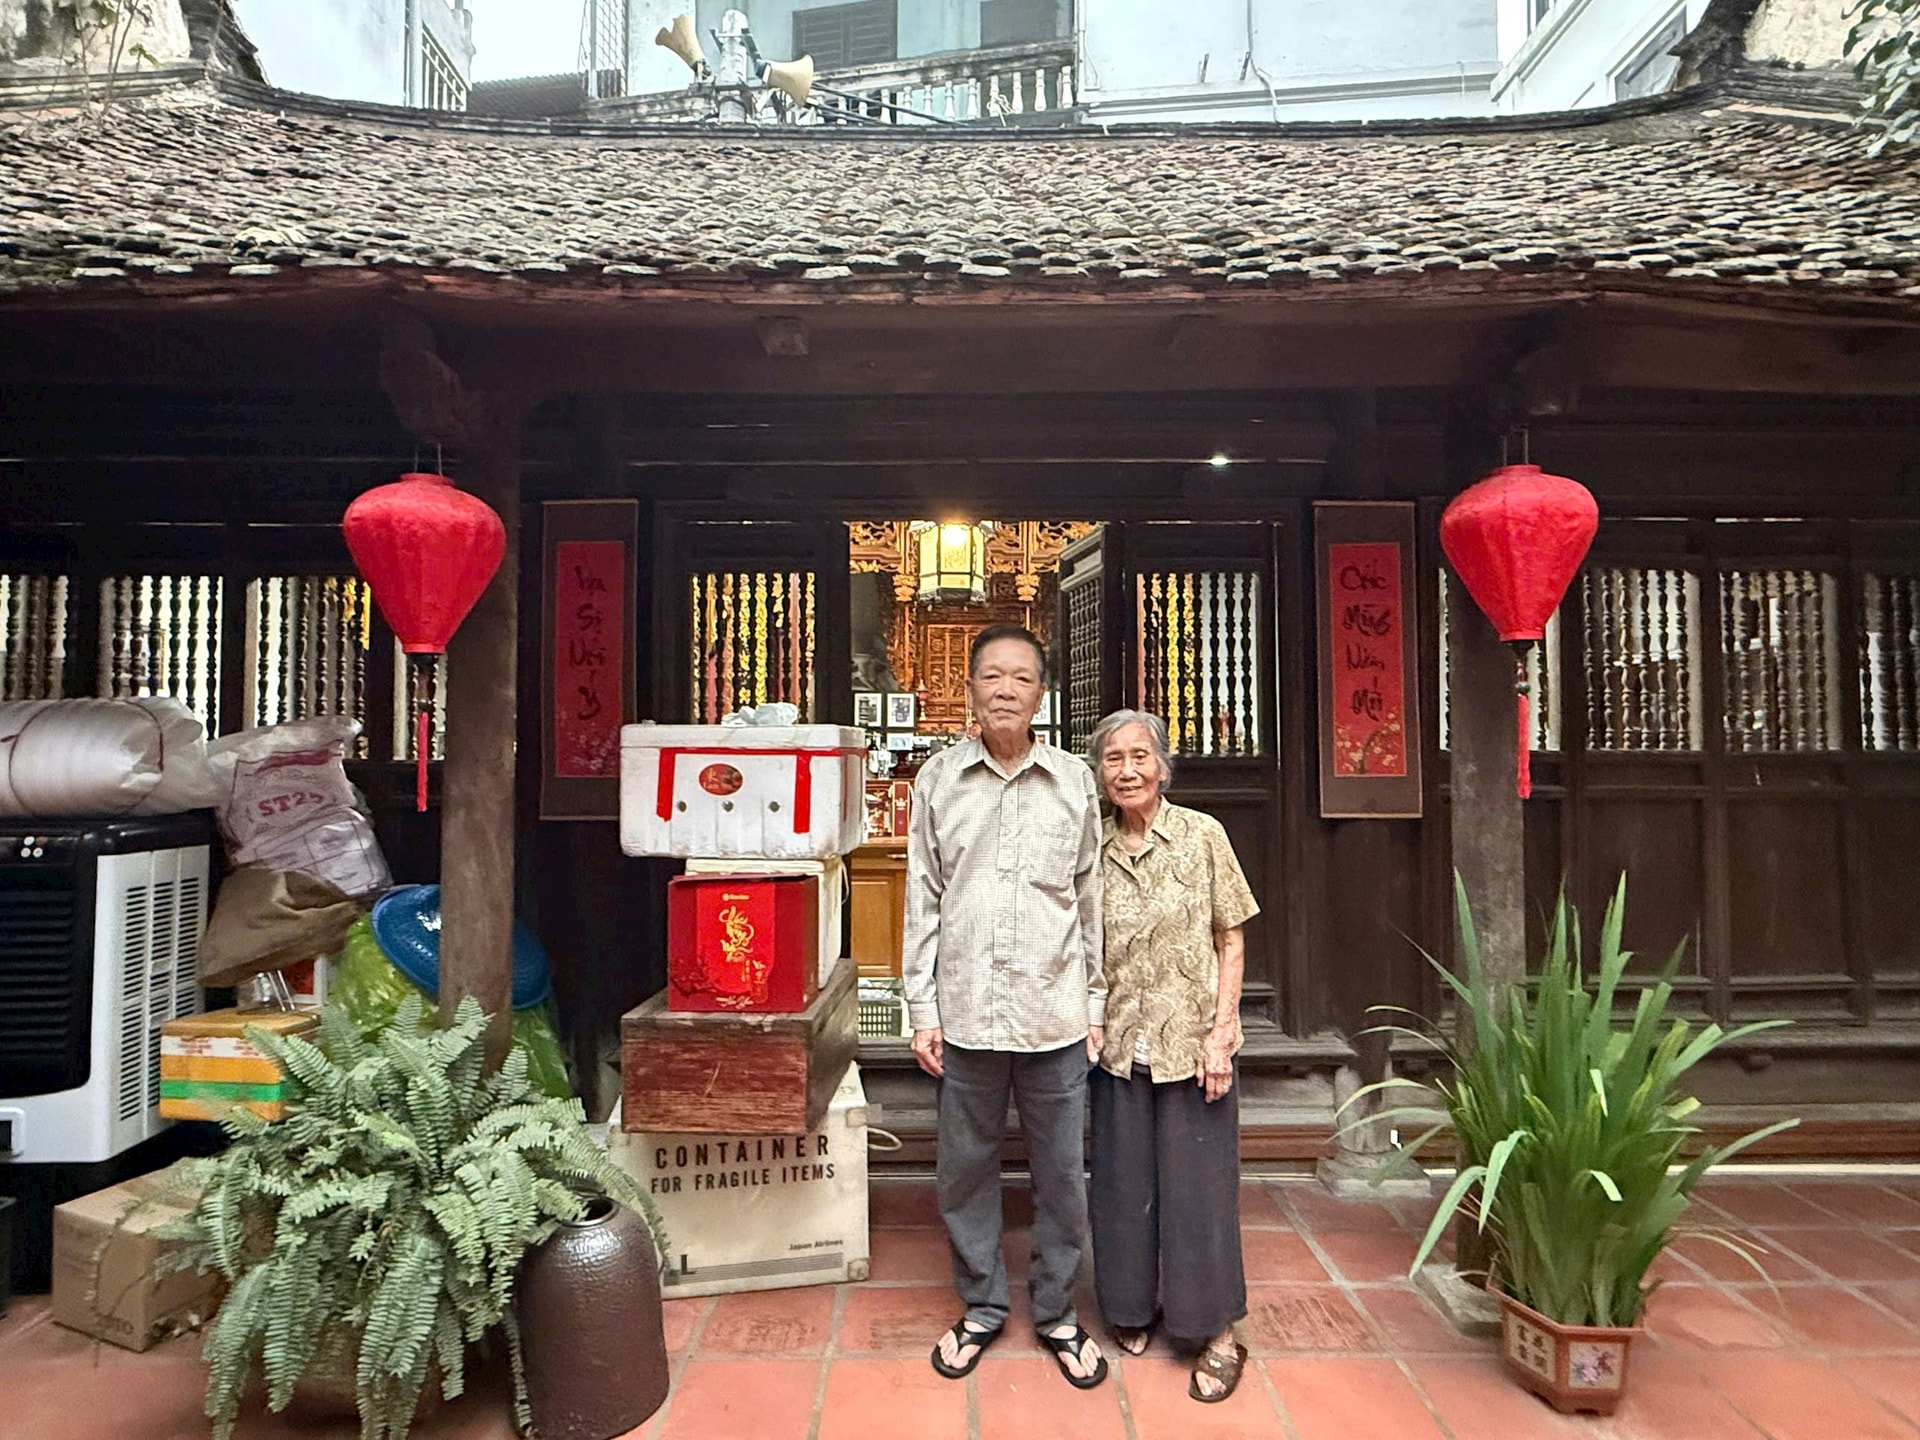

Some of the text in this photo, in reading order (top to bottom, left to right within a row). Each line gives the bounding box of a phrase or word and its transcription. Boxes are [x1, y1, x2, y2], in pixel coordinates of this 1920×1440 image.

[655, 1134, 829, 1170] CONTAINER
[651, 1163, 836, 1194] FOR FRAGILE ITEMS
[789, 1239, 843, 1251] Japan Airlines
